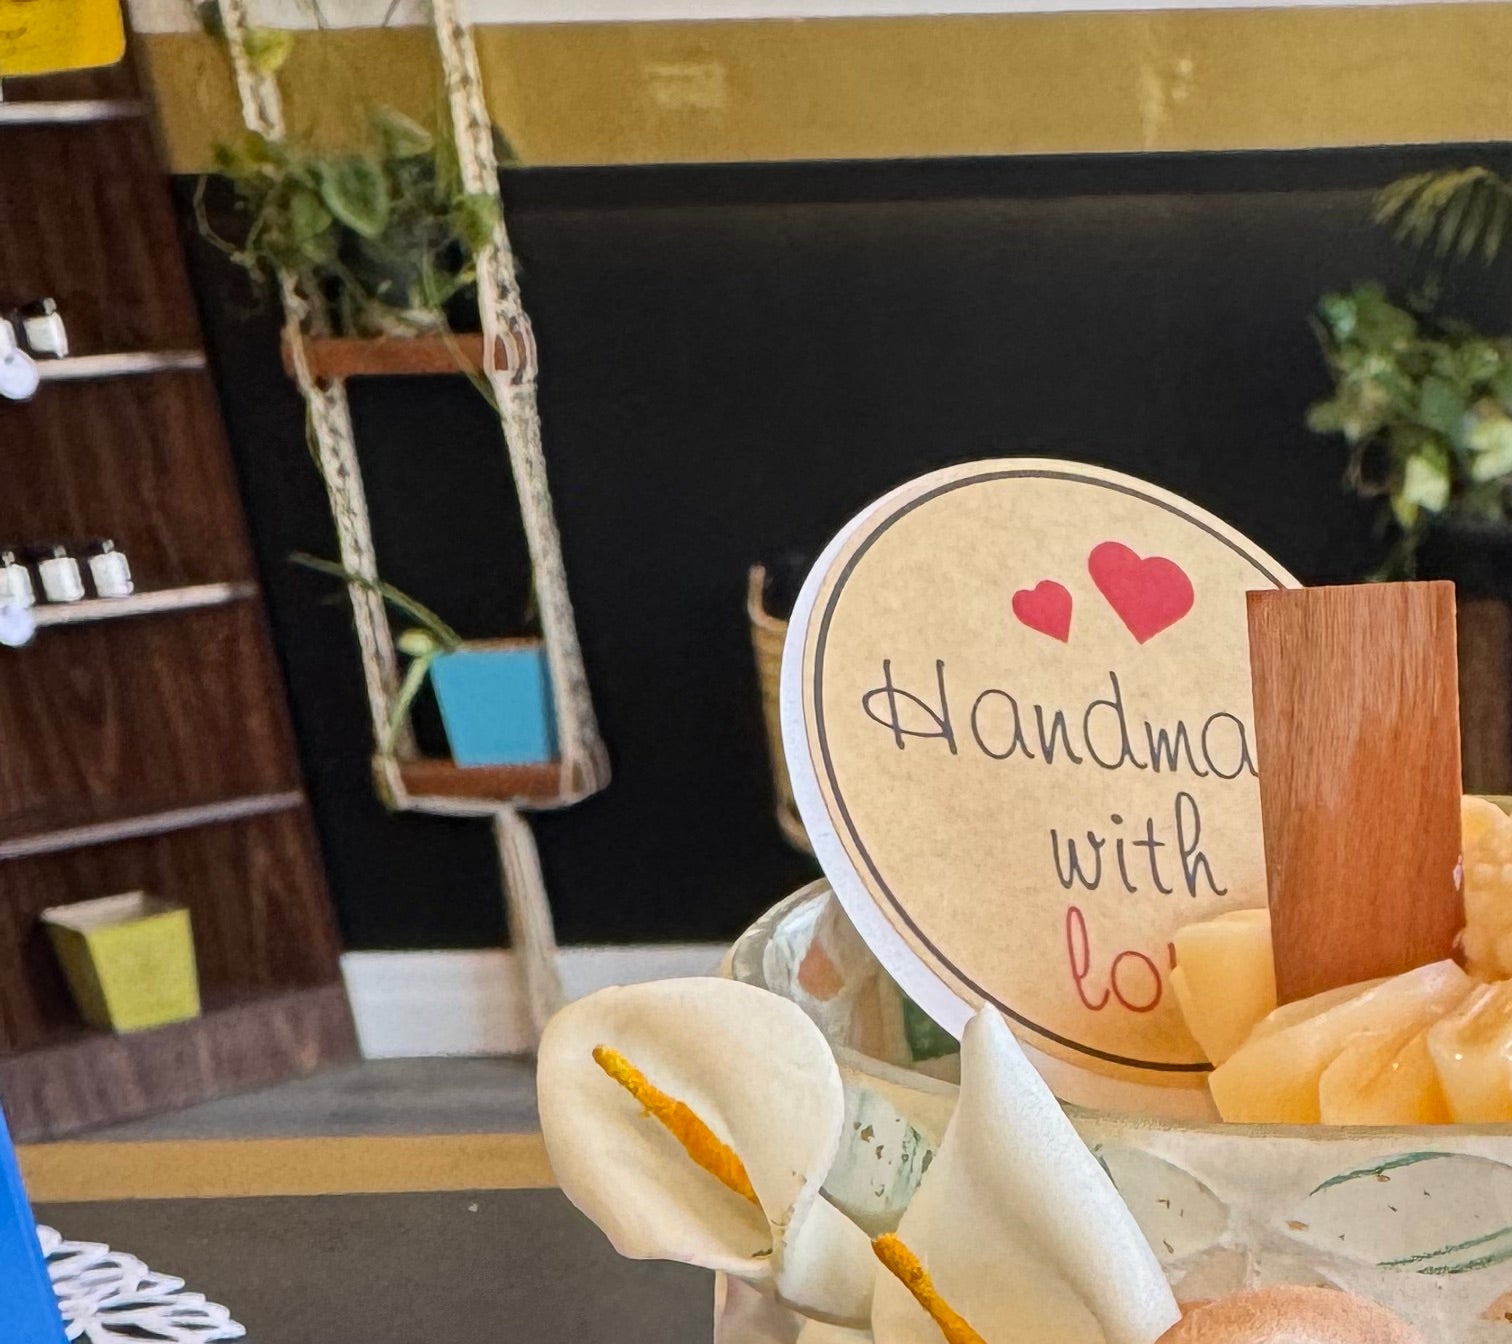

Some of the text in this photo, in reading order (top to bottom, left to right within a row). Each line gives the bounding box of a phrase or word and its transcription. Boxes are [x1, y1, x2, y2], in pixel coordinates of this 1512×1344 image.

[861, 658, 1259, 780] Handma
[1050, 792, 1228, 898] with
[1066, 906, 1177, 1013] lo
